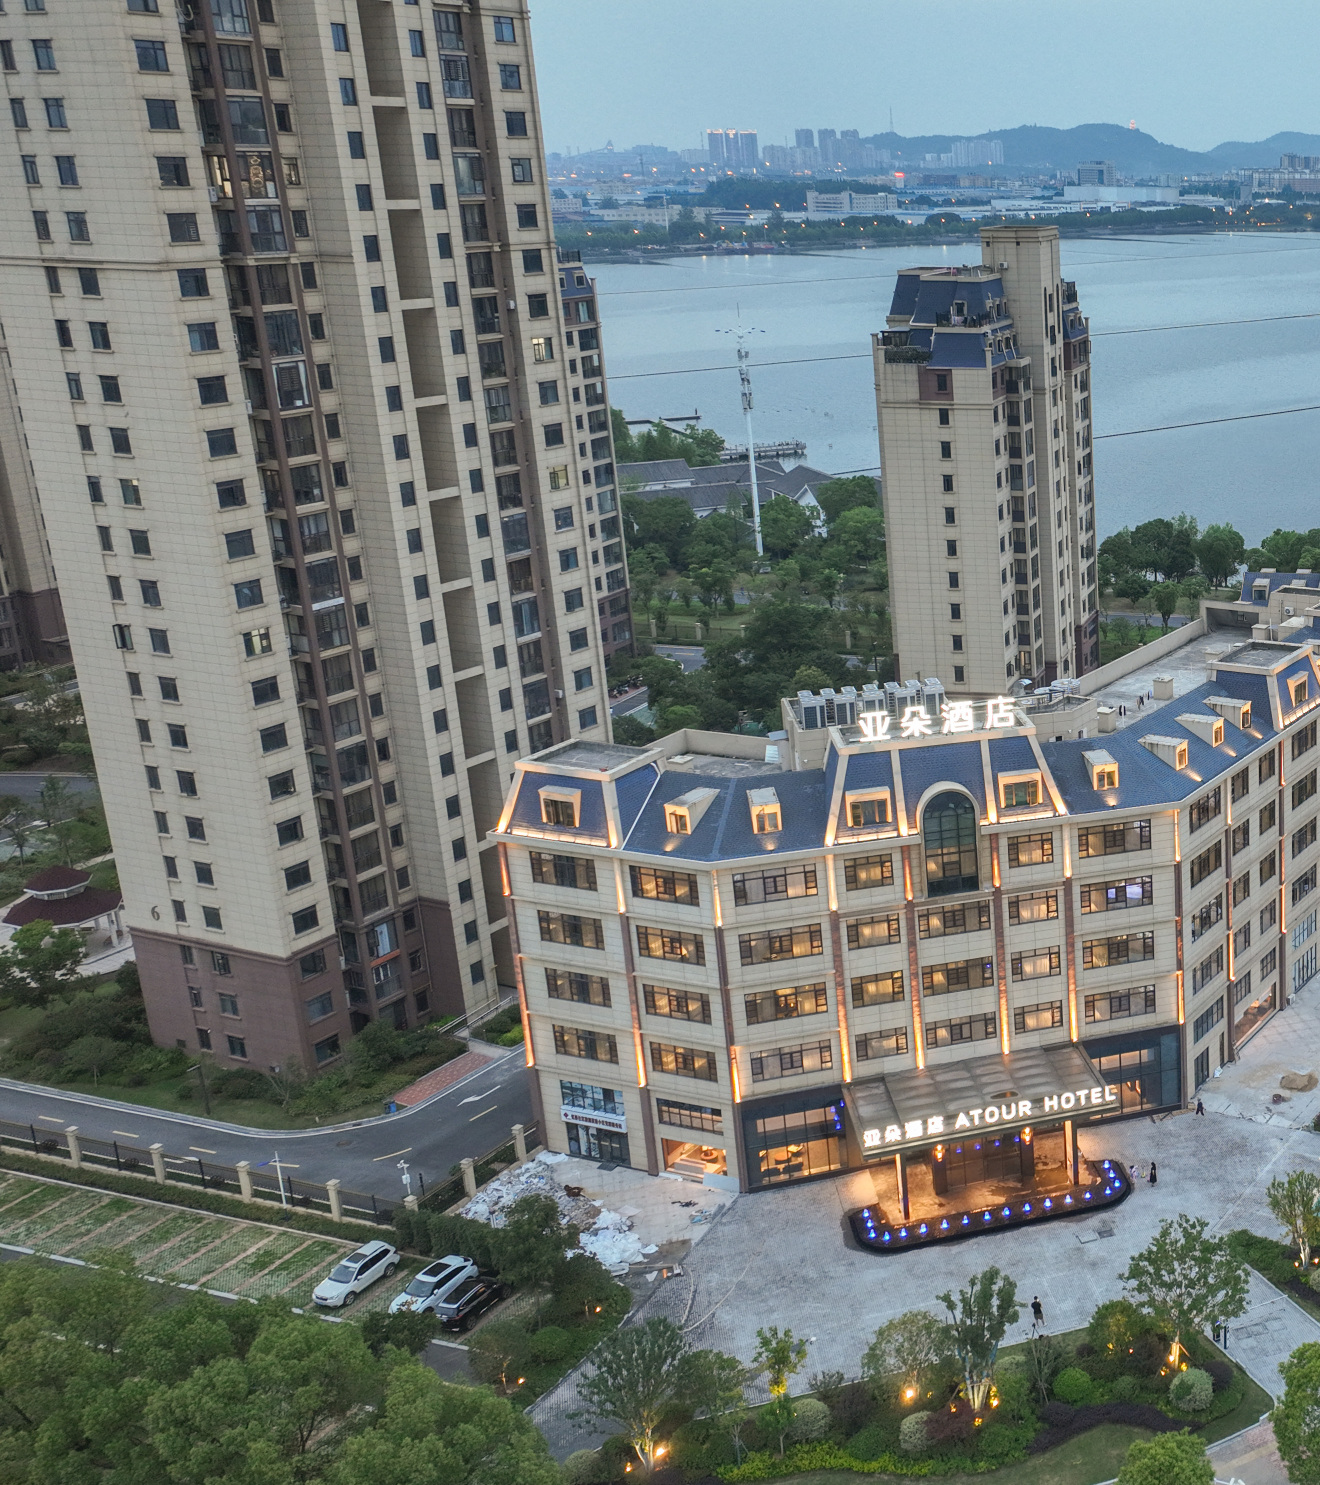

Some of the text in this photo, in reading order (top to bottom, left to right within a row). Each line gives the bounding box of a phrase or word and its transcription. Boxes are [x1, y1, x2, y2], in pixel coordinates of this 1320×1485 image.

[858, 695, 1015, 742] 亚朵酒店
[150, 905, 160, 921] 6
[863, 1086, 1117, 1148] 亚朵酒店 ATOUR HOTEL
